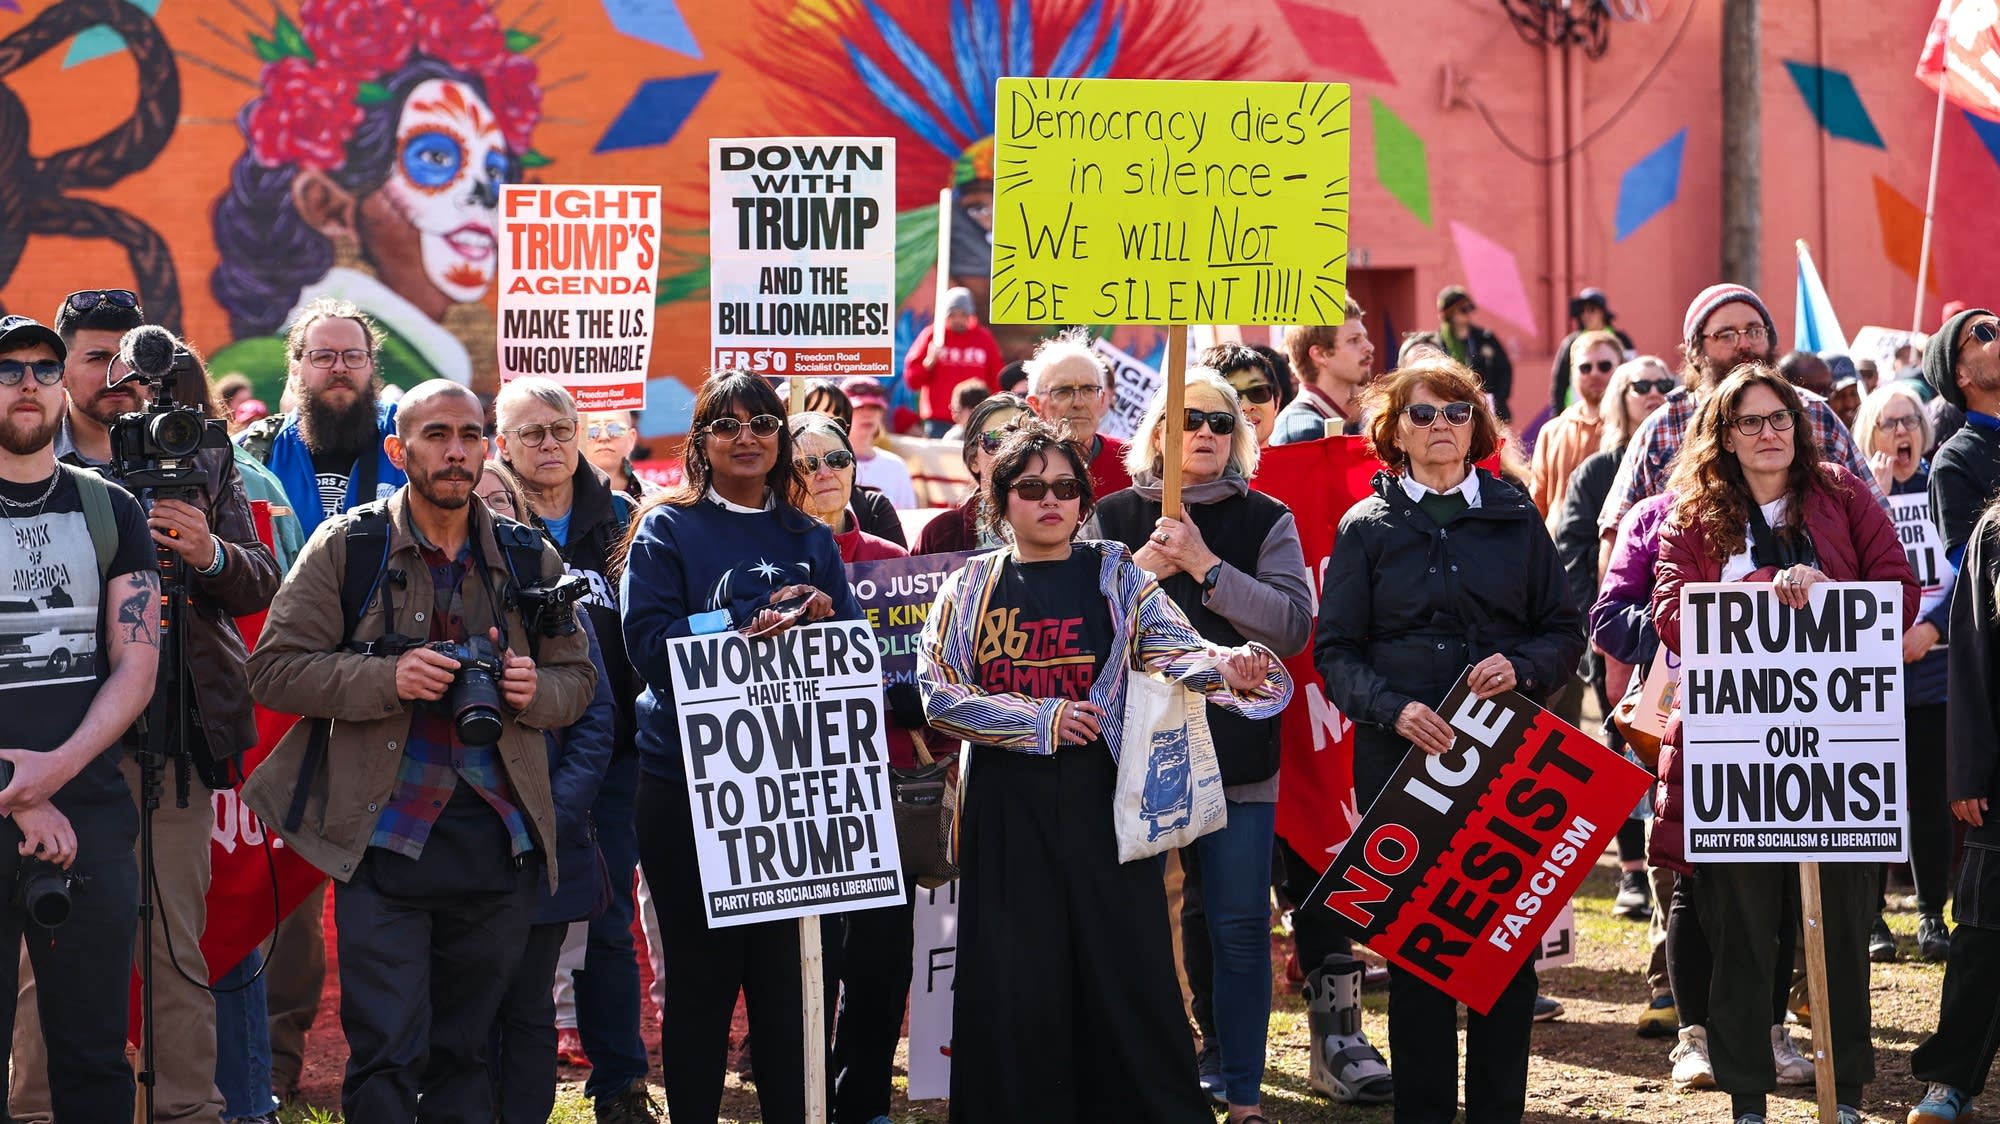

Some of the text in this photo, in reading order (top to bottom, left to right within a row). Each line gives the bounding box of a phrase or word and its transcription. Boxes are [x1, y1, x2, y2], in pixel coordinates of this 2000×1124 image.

[1012, 91, 1306, 153] Democracy dies
[720, 145, 883, 171] DOWN
[1069, 157, 1103, 195] in
[1123, 144, 1272, 196] silence
[751, 174, 852, 194] WITH
[505, 189, 657, 219] FIGHT
[732, 197, 879, 251] TRUMP
[1019, 202, 1278, 263] WE WILL NOT
[507, 223, 655, 271] TRUMP'S
[507, 276, 652, 296] AGENDA
[759, 266, 848, 296] AND THE
[1025, 280, 1069, 320] BE
[504, 309, 649, 339] MAKE THE U.S.
[718, 301, 889, 337] BILLIONAIRES!
[505, 344, 645, 375] UNGOVERNABLE
[794, 362, 889, 374] Socialist Organization
[795, 352, 860, 362] Freedom Road
[577, 390, 609, 399] Freedom
[15, 523, 51, 549] BANK
[29, 551, 42, 565] OF
[13, 563, 71, 591] AMERICA
[978, 607, 1083, 665] 86 ICE
[1688, 588, 1895, 655] TRUMP:
[674, 626, 874, 690] WORKERS
[746, 680, 821, 706] HAVE THE
[1688, 667, 1897, 714] HANDS OFF
[685, 697, 879, 780] POWER
[1766, 727, 1820, 758] OUR
[696, 765, 882, 829] TO DEFEAT
[1323, 823, 1419, 929] NO
[1403, 691, 1516, 815] ICE
[1691, 762, 1897, 822] UNIONS!
[718, 813, 881, 886] TRUMP!
[1396, 729, 1595, 982] RESIST
[1695, 832, 1897, 848] PARTY FOR SOCIALISM & LIBERATION
[714, 876, 895, 912] PARTY FOR SOCIALISM & LIBERATION
[1488, 815, 1597, 952] FASCISM
